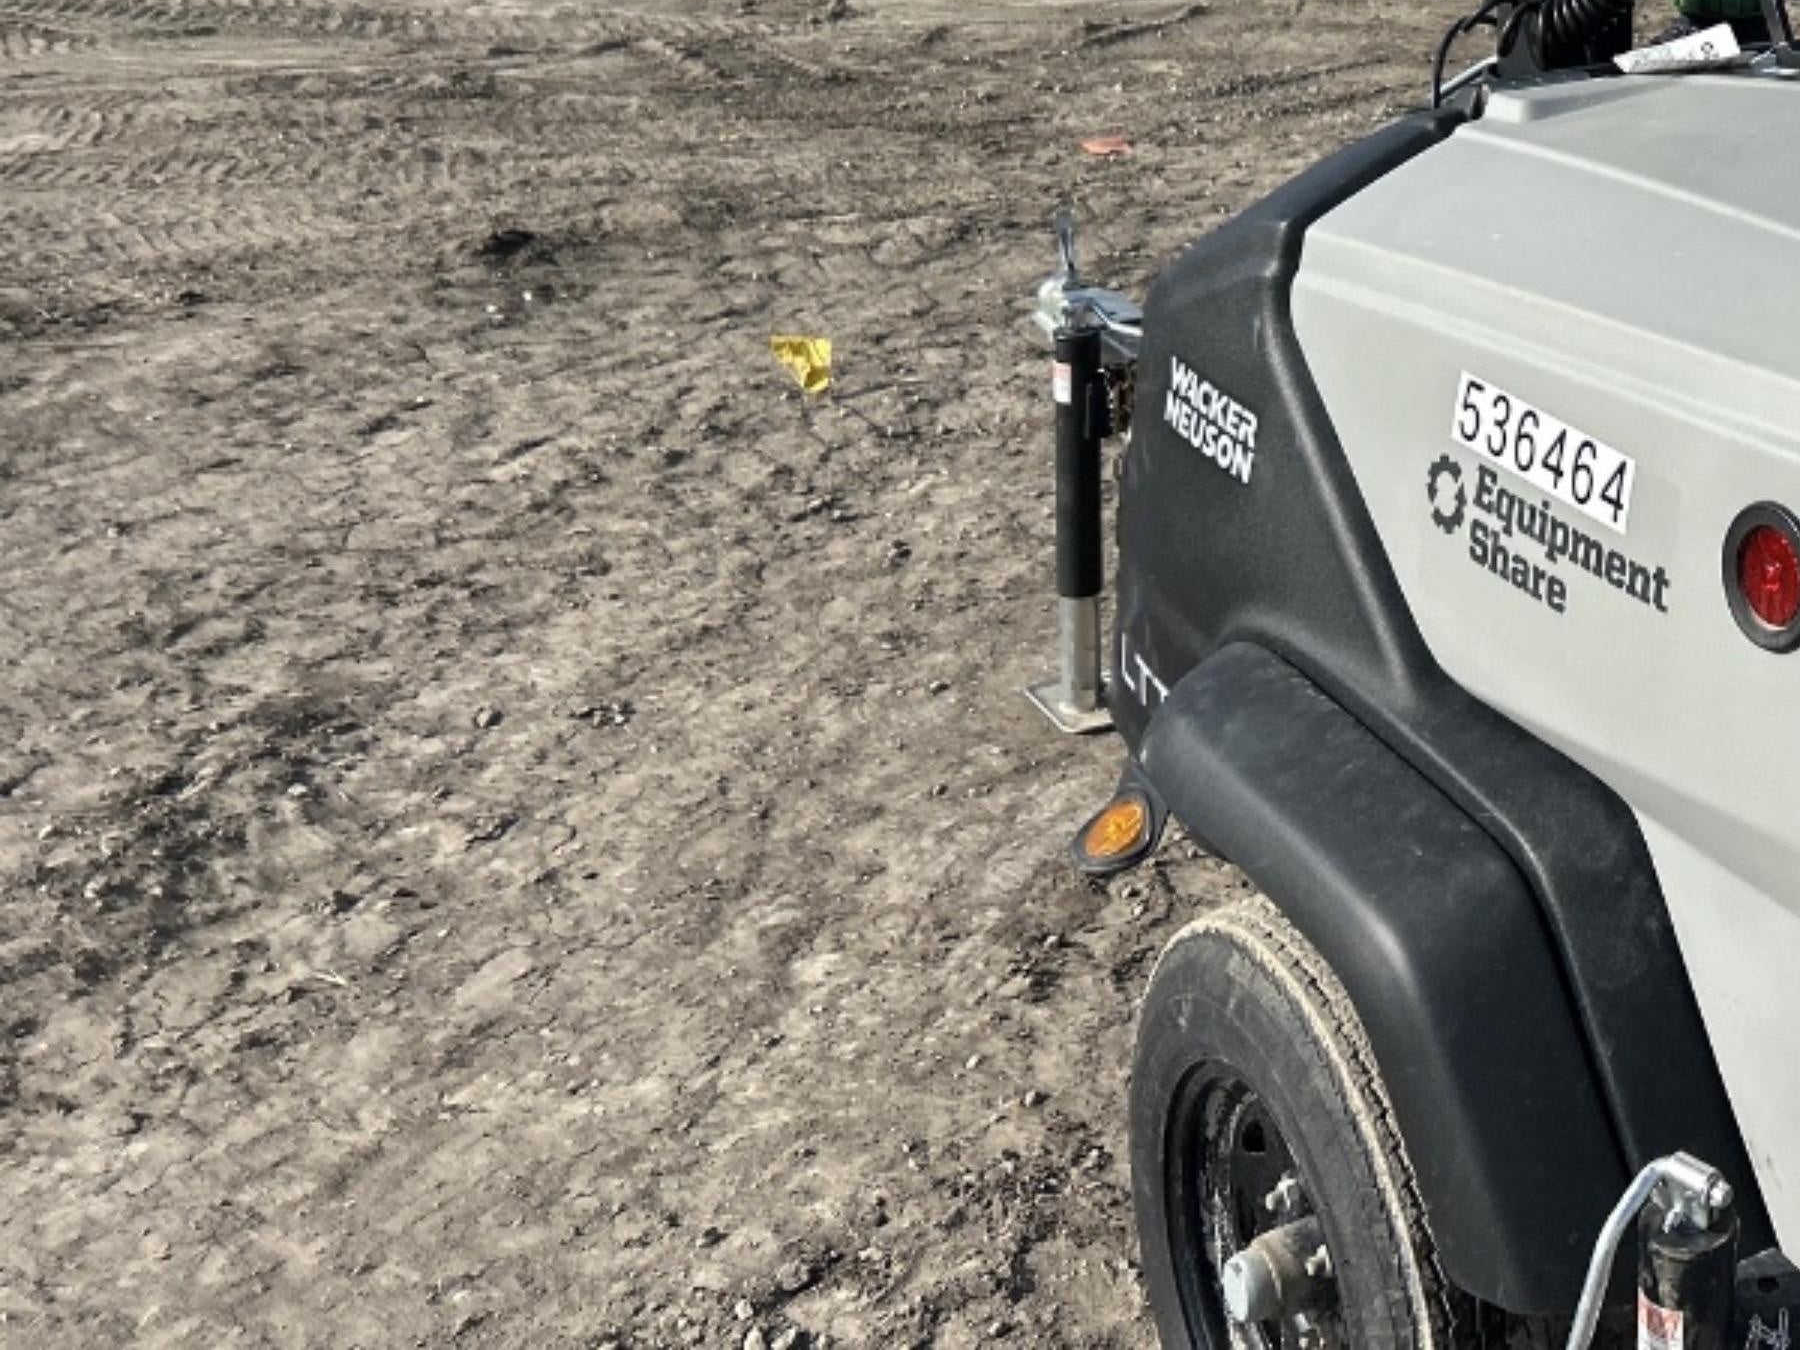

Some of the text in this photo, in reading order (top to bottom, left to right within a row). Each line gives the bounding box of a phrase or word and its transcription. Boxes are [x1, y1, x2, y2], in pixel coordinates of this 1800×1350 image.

[1163, 389, 1255, 484] NEUSON
[1172, 355, 1258, 449] WACKER
[1458, 380, 1627, 523] 536464
[1469, 518, 1567, 614] Share
[1472, 464, 1670, 612] Equipment
